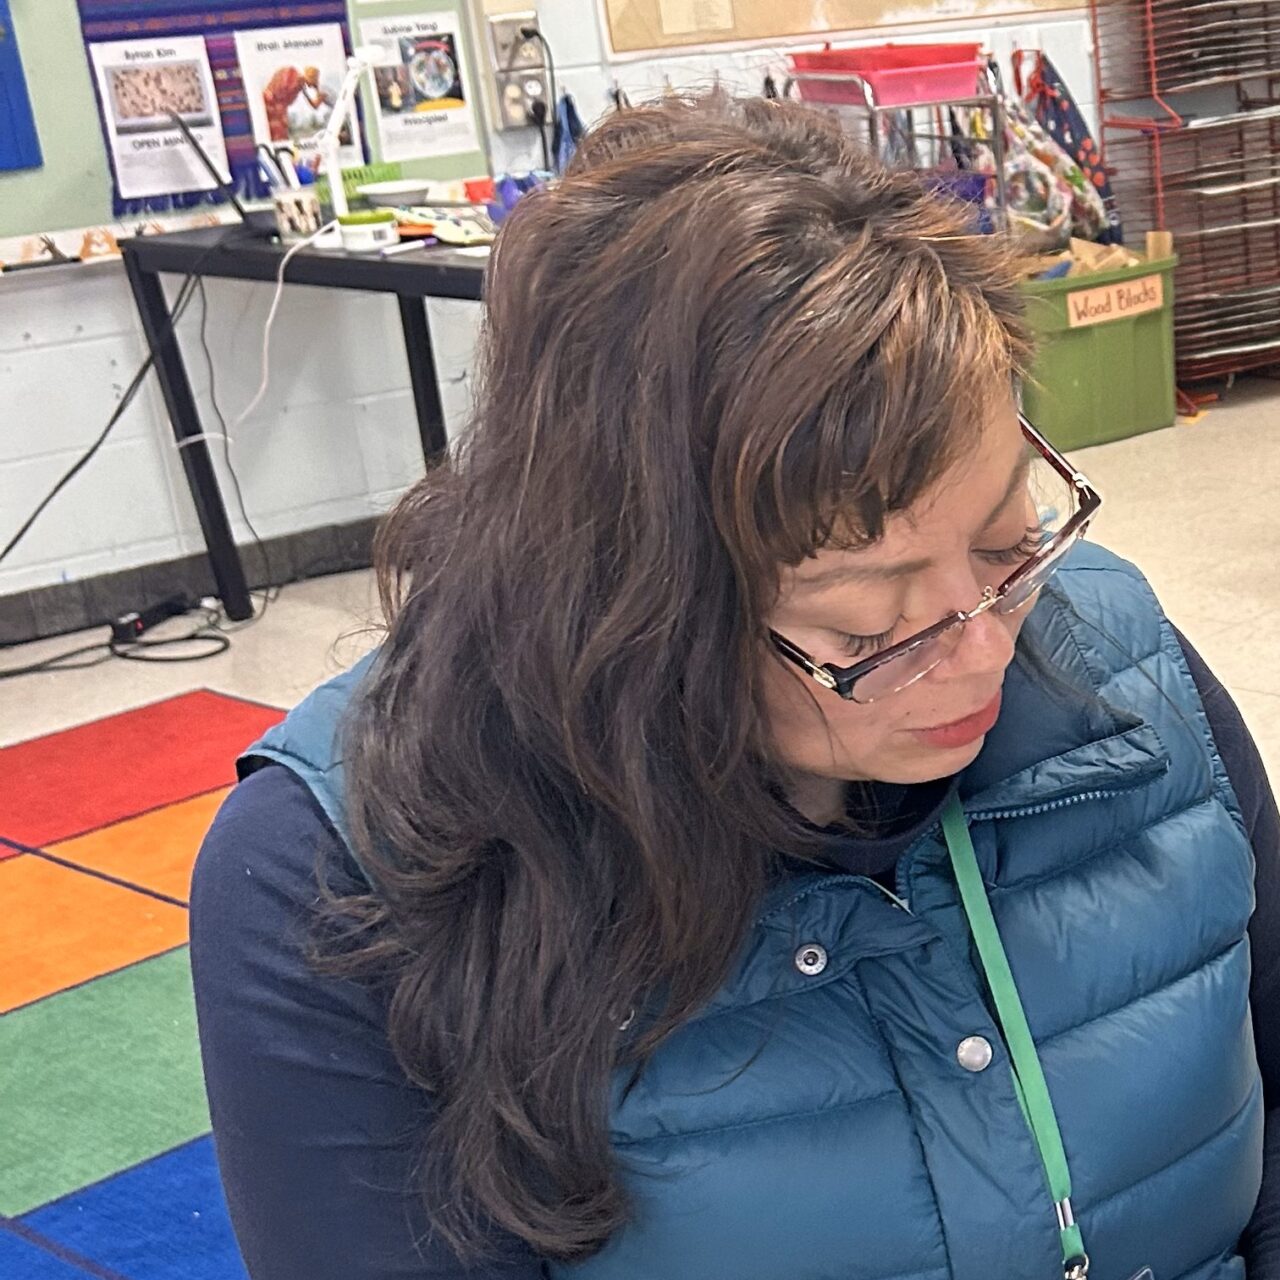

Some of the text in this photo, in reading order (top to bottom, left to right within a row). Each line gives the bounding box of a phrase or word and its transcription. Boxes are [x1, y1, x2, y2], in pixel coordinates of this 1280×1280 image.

[157, 47, 177, 58] Kim
[132, 137, 160, 150] OPEN
[1073, 281, 1157, 321] Wood Blocks
